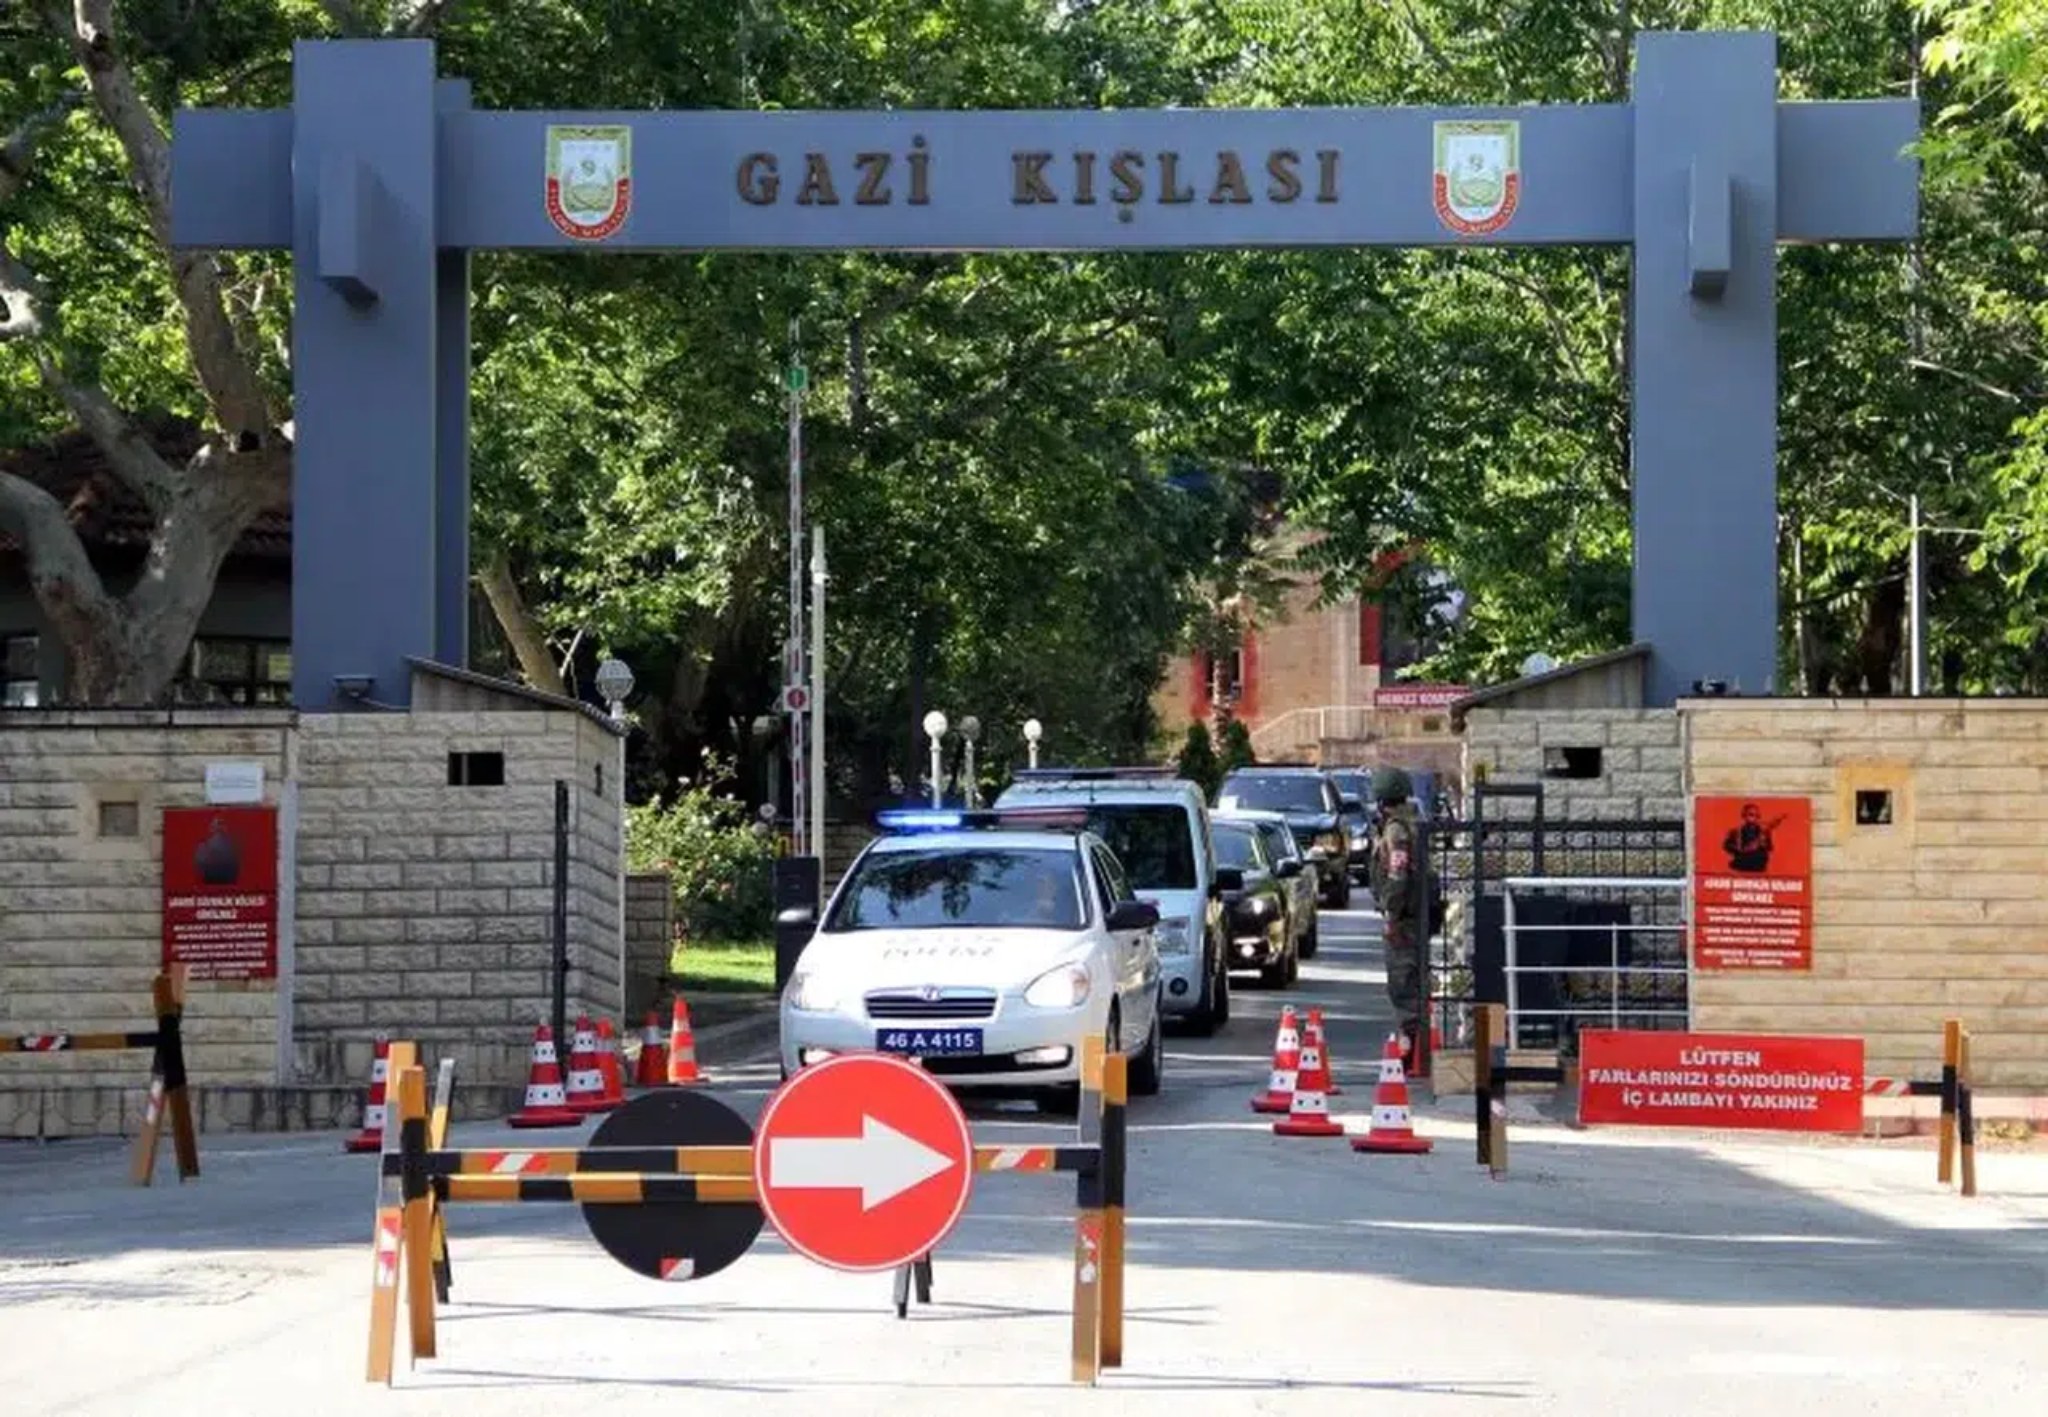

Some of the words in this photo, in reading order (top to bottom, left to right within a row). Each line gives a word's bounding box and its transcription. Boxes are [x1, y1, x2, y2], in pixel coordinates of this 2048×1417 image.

[735, 133, 931, 206] GAZİ
[1009, 150, 1341, 224] KIŞLASI
[885, 1032, 908, 1048] 46
[911, 1032, 927, 1048] A
[930, 1032, 975, 1048] 4115
[1680, 1046, 1761, 1067] LÜTFEN
[1588, 1068, 1709, 1086] FARLARINIZI
[1713, 1069, 1853, 1091] SÖNDÜRÜNÜZ
[1623, 1087, 1643, 1109] İÇ
[1648, 1091, 1734, 1108] LAMBAYI
[1739, 1093, 1819, 1110] YAKINIZ
